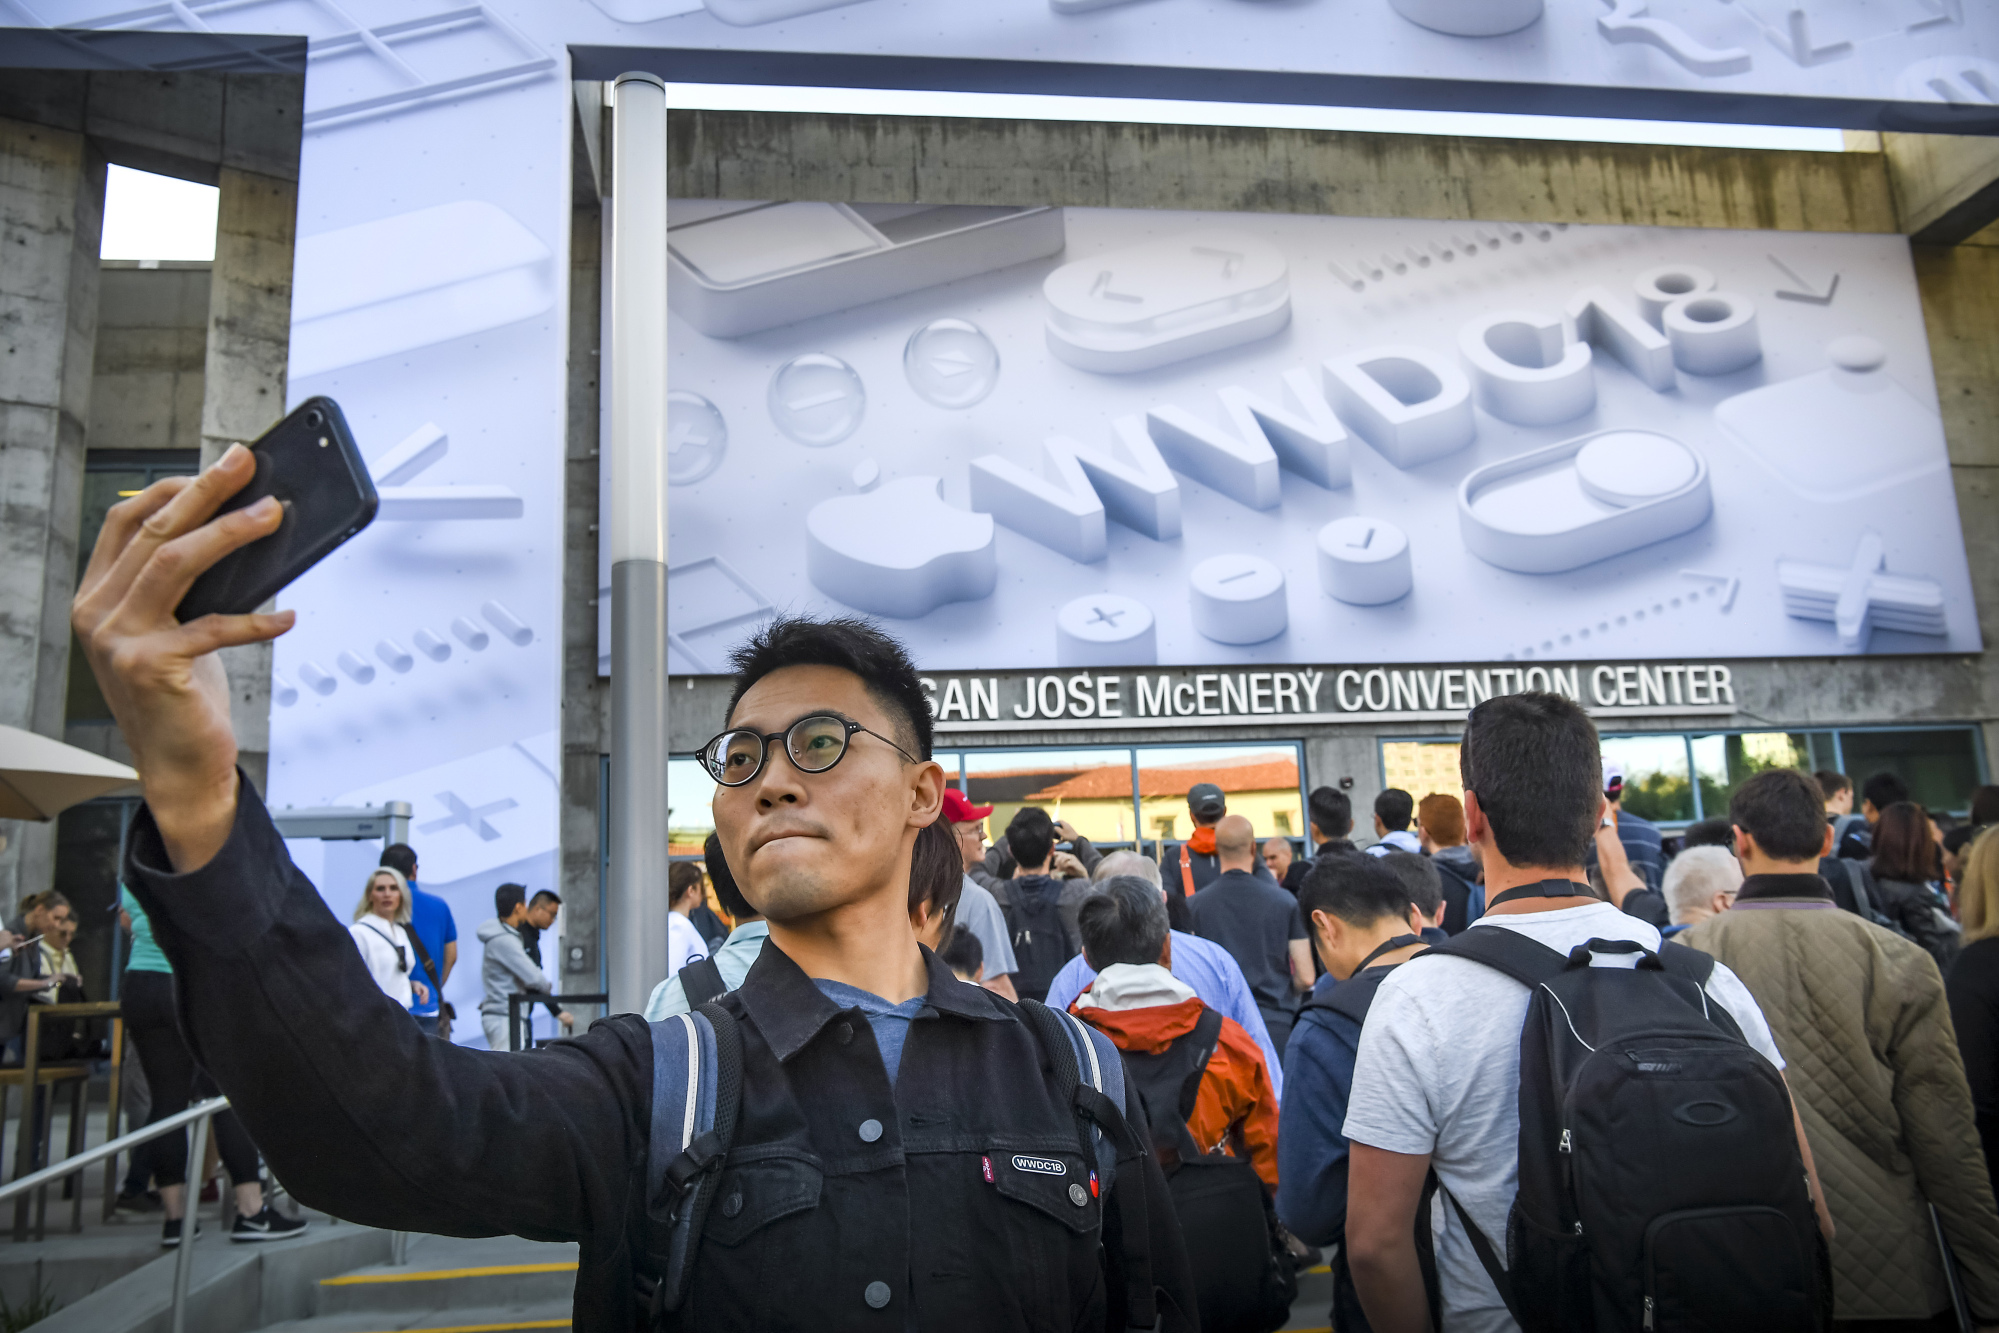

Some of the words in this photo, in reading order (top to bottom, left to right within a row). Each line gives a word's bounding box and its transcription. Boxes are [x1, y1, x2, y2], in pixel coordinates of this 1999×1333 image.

[970, 264, 1760, 564] WWDC18
[918, 677, 999, 720] SAN
[1013, 672, 1122, 718] JOSE
[1136, 669, 1323, 716] McENERY
[1336, 666, 1580, 712] CONVENTION
[1592, 664, 1735, 706] CENTER
[1016, 1158, 1062, 1172] WWDC18
